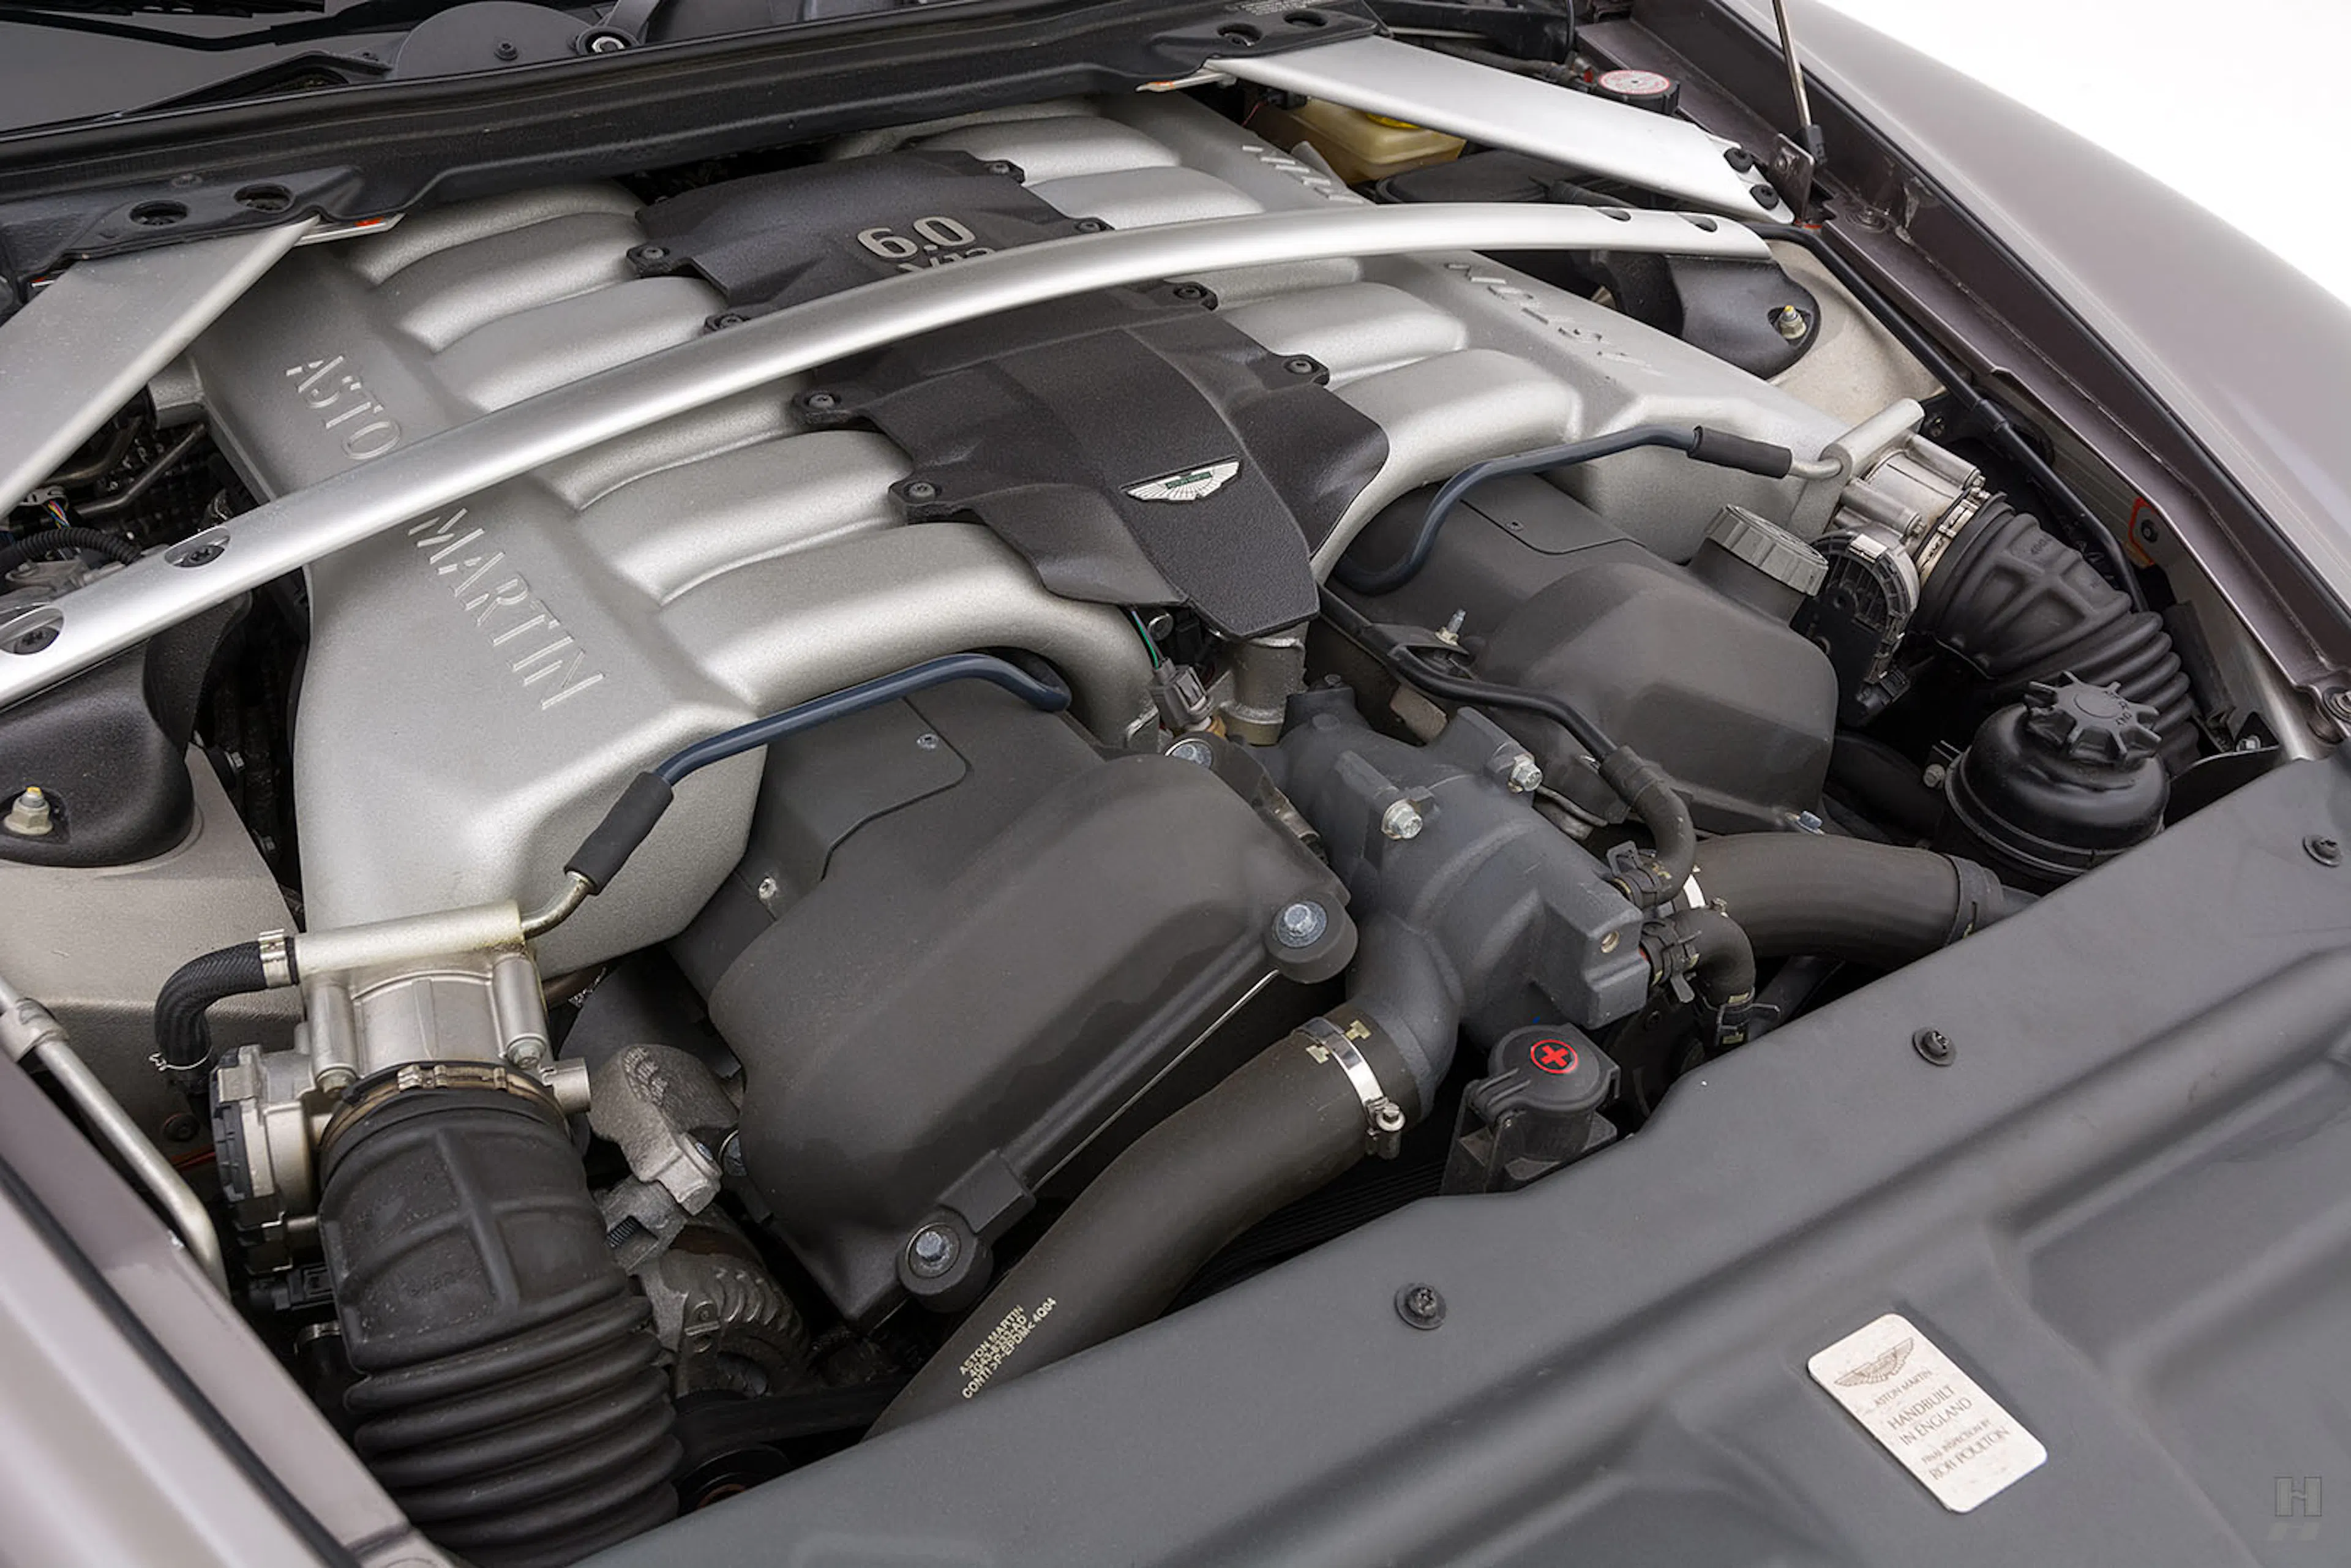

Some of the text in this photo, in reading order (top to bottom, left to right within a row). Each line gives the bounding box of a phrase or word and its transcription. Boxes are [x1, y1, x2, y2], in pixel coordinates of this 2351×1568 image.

[857, 217, 976, 258] 6.0
[285, 354, 605, 711] ASTO MARTIN
[959, 1304, 1024, 1376] ASTON MARTIN
[962, 1366, 993, 1399] CONTI
[1874, 1370, 1933, 1407] ASTON MARTIN
[1887, 1384, 1956, 1431] HANDBUILT
[1899, 1397, 1973, 1447] IN ENGLAND
